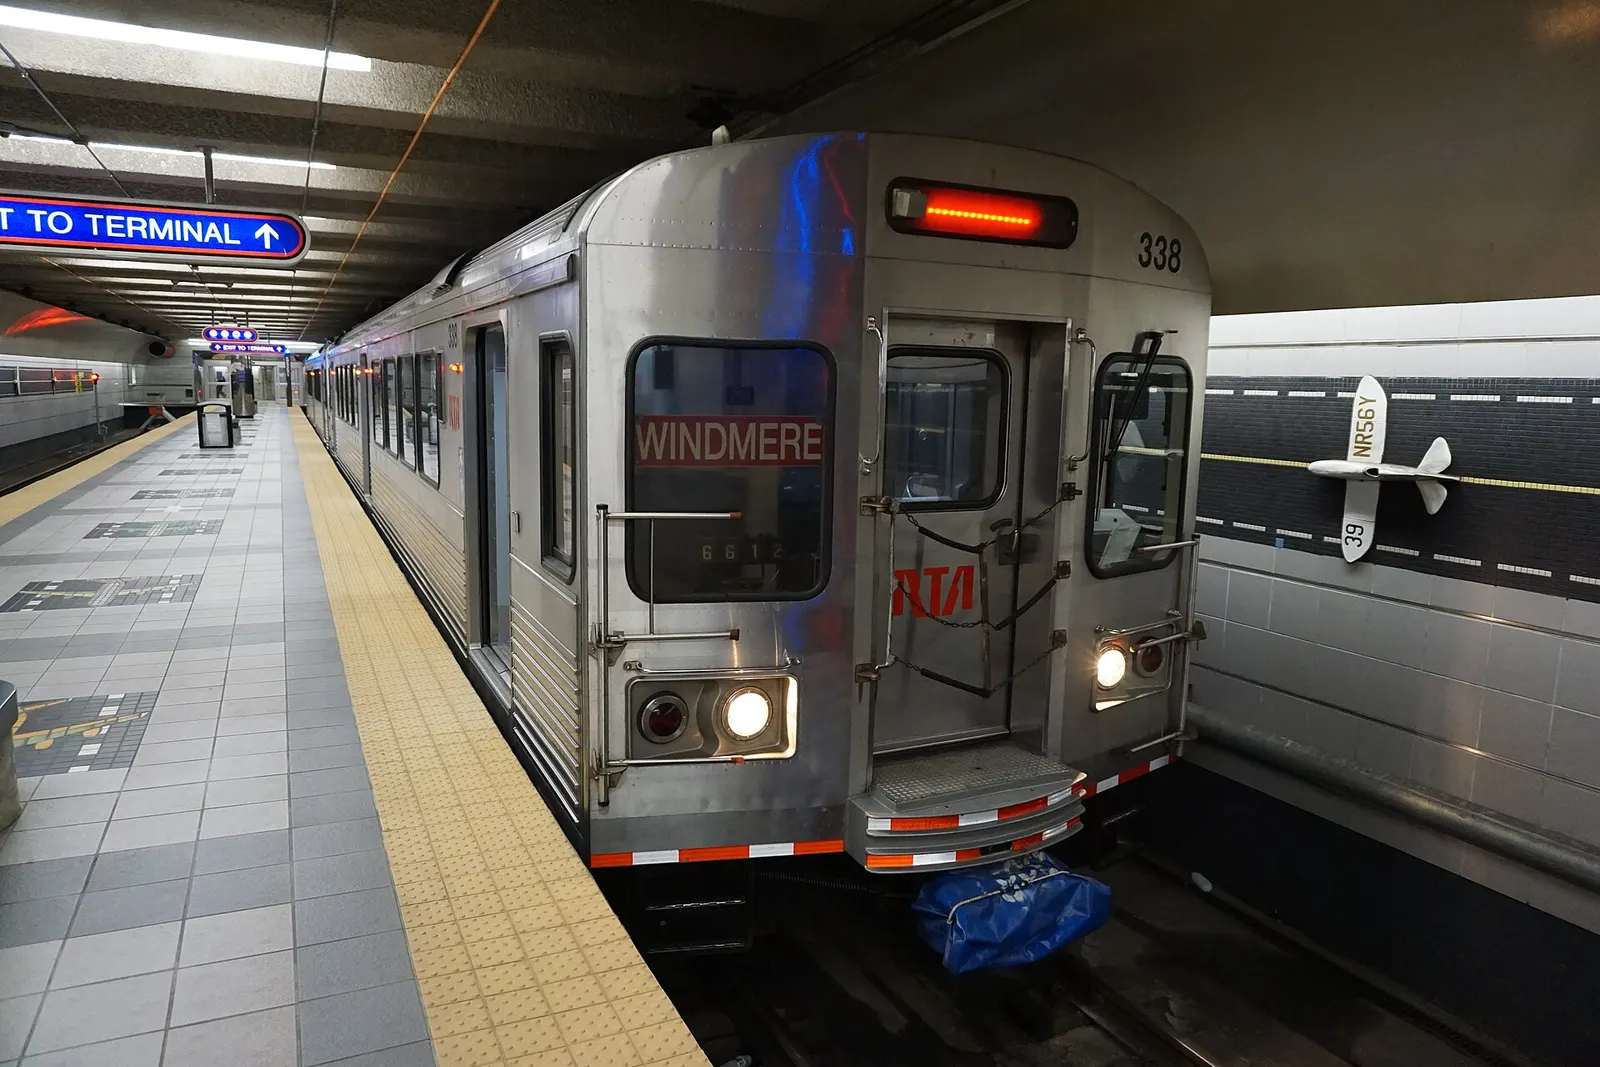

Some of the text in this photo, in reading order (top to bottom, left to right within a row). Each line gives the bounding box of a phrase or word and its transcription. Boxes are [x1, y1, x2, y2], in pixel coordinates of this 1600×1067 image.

[27, 209, 73, 235] TO
[84, 213, 241, 245] TERMINAL
[1138, 231, 1182, 274] 338
[635, 421, 822, 461] WINDMERE
[1353, 396, 1377, 458] NR56Y
[1344, 524, 1364, 548] 39
[892, 565, 975, 618] RTA
